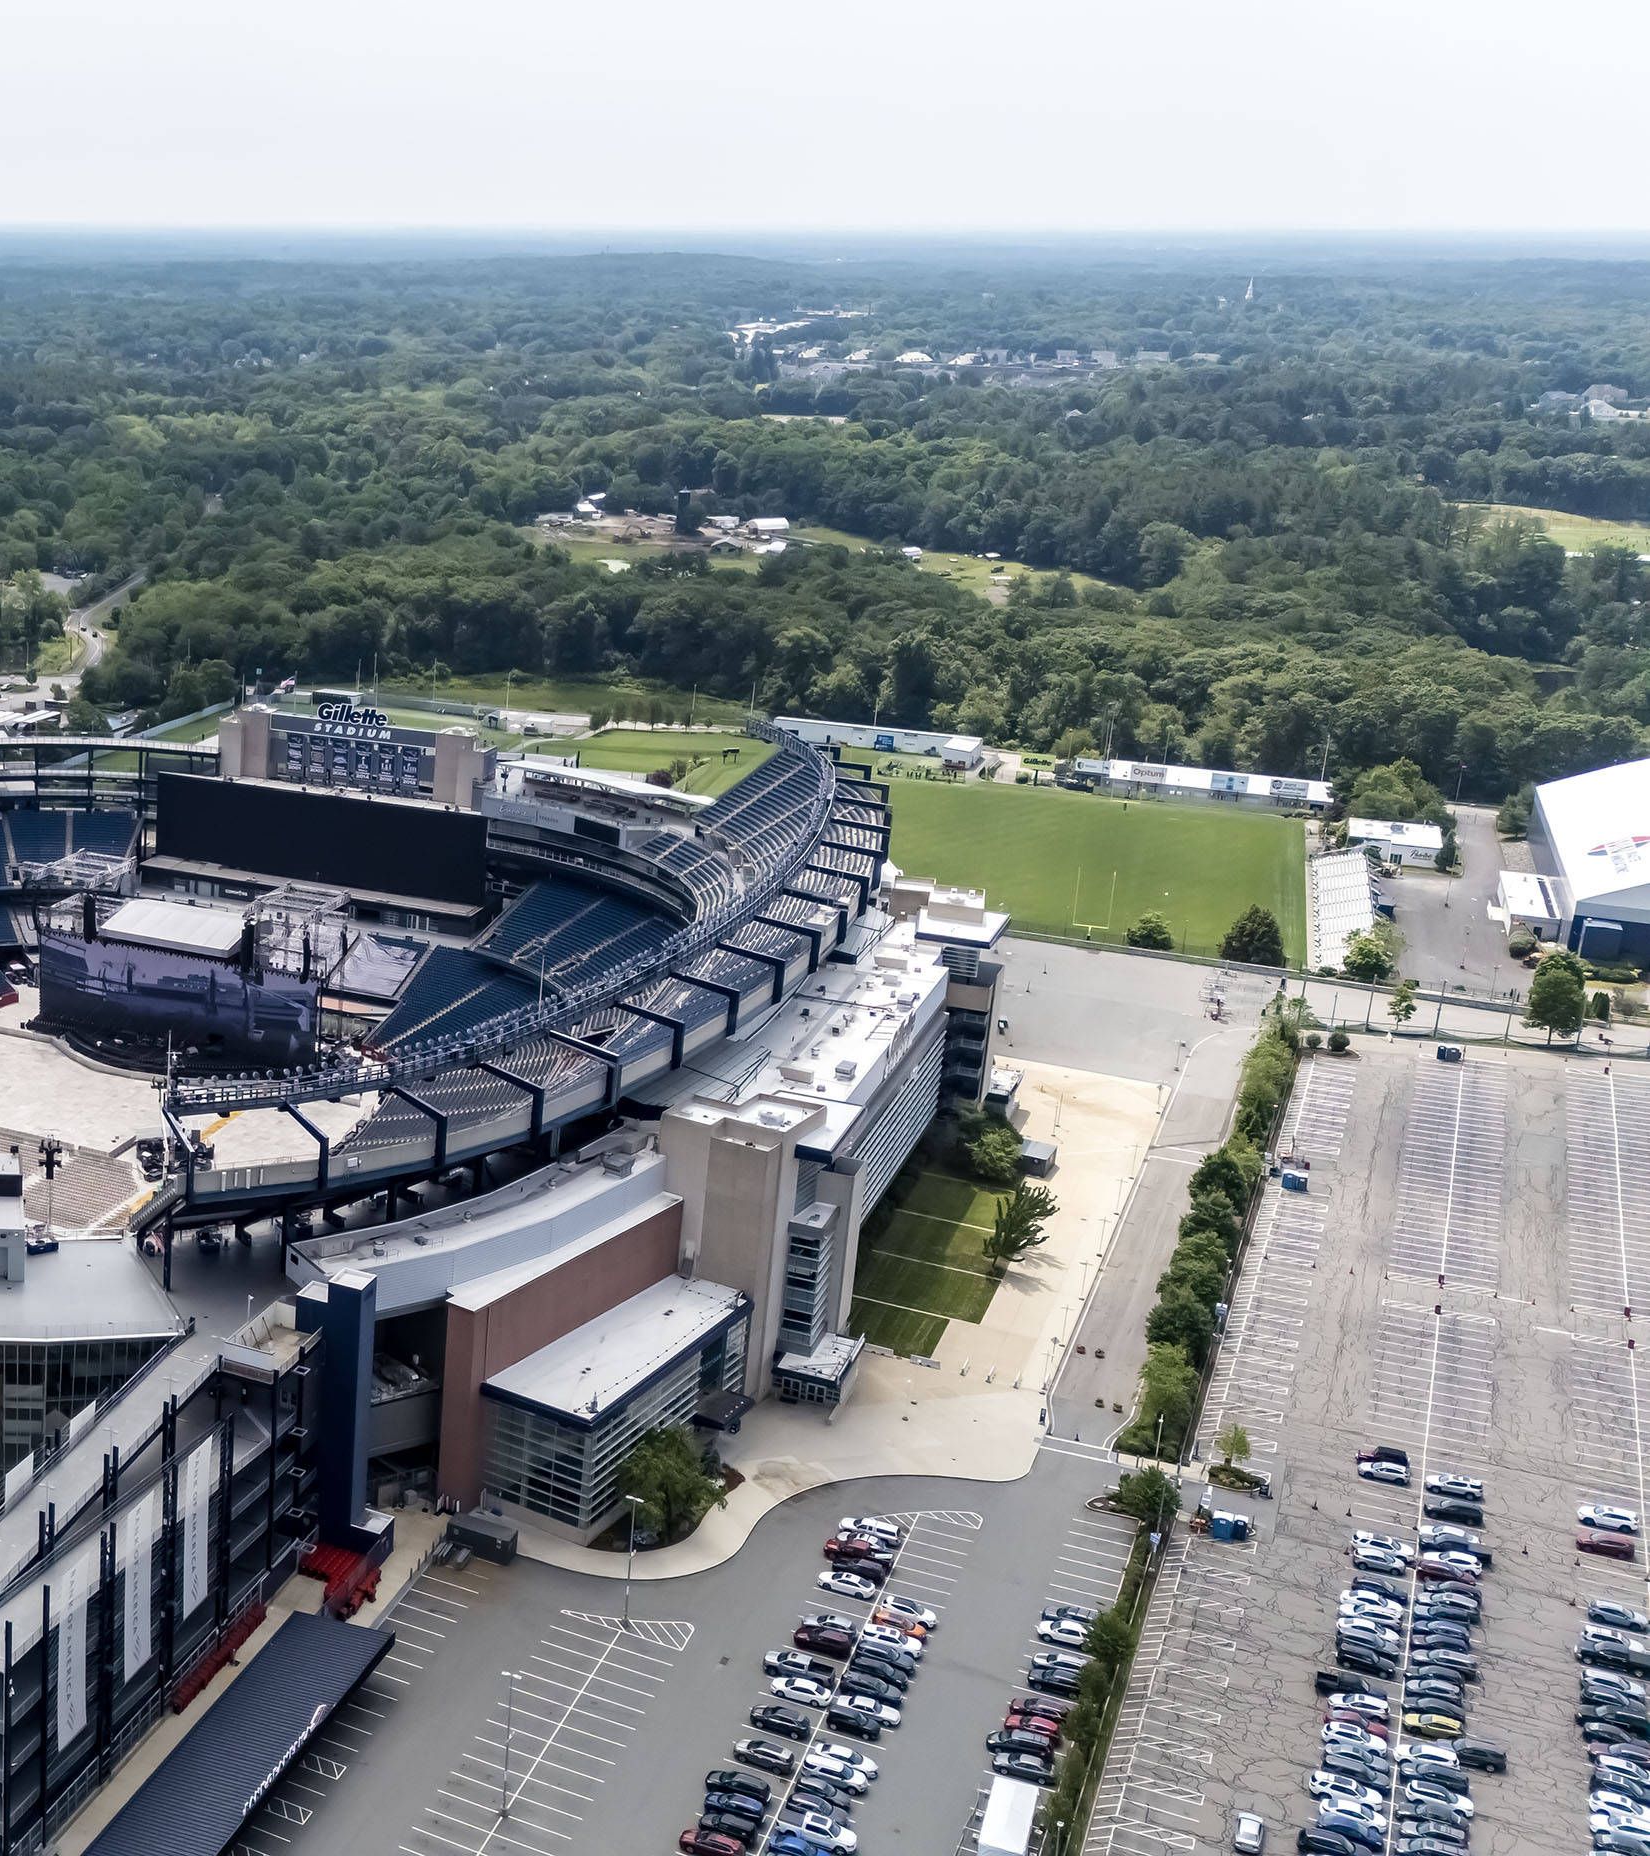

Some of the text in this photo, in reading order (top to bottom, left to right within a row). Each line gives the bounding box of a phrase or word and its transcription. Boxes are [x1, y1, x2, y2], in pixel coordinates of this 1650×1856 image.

[317, 703, 387, 727] Gillette
[313, 722, 392, 740] STADIUM
[1023, 757, 1052, 767] Gillette
[1133, 768, 1165, 778] Optum
[65, 1635, 73, 1703] AMERICA
